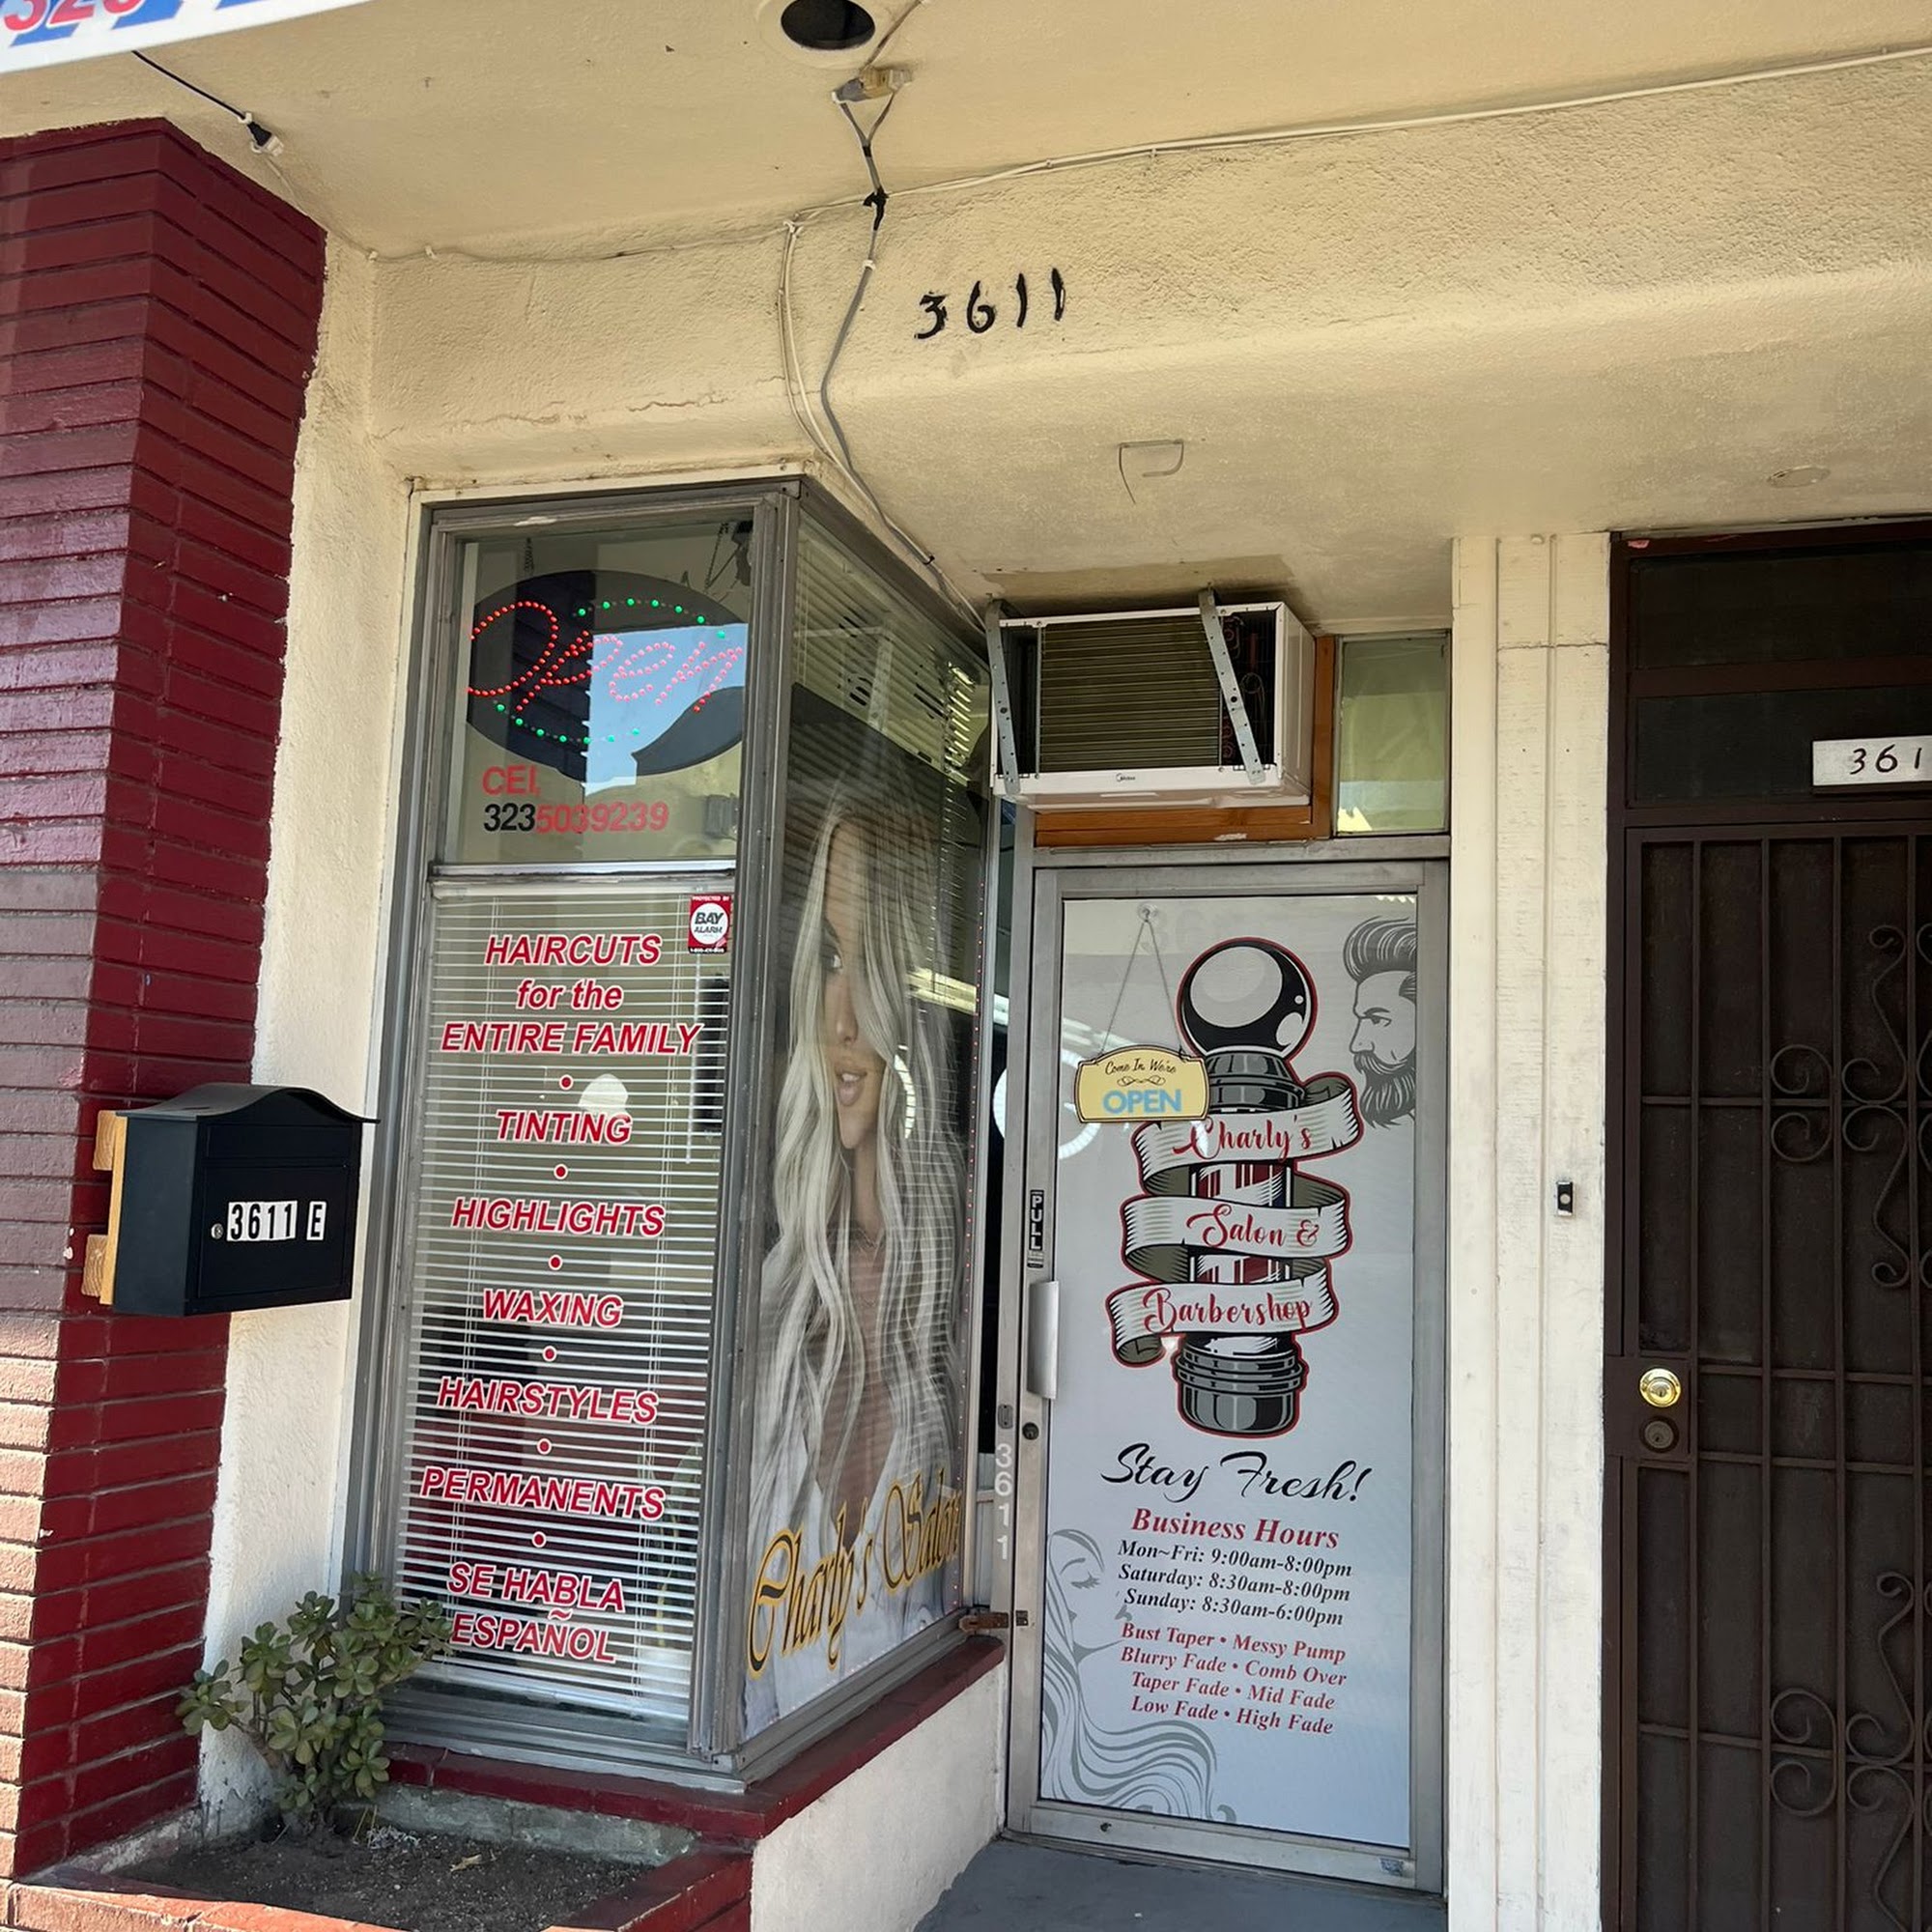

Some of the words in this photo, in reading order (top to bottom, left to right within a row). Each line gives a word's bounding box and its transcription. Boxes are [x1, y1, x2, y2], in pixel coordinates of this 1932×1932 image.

[914, 267, 1066, 339] 3611
[1849, 744, 1921, 775] 361
[695, 912, 724, 924] BAY
[484, 934, 662, 966] HAIRCUTS
[516, 979, 564, 1009] for
[570, 979, 623, 1009] the
[440, 1022, 566, 1052] ENTIRE
[572, 1023, 703, 1055] FAMILY
[1102, 1089, 1182, 1114] OPEN
[497, 1111, 632, 1145] TINTING
[1172, 1115, 1312, 1163] Charly's
[230, 1204, 293, 1239] 3611
[311, 1204, 322, 1238] E
[451, 1197, 666, 1237] HIGHLIGHTS
[1030, 1195, 1042, 1250] PULL
[1186, 1204, 1287, 1247] Salon
[1296, 1219, 1320, 1247] &
[483, 1289, 624, 1328] WAXING
[1143, 1288, 1311, 1334] Barbershop
[437, 1376, 659, 1424] HAIRSTYLES
[419, 1464, 667, 1521] PERMANENTS
[1100, 1442, 1209, 1503] Stay
[1220, 1450, 1372, 1502] Fresh!
[994, 1443, 1013, 1560] 3611
[1131, 1507, 1245, 1541] Business
[1254, 1519, 1340, 1549] Hours
[1118, 1564, 1204, 1590] Saturday:
[1208, 1572, 1350, 1604] 8:30am-8:00pm
[1210, 1548, 1352, 1579] 9:00am-8:00pm
[446, 1562, 497, 1597] SE
[502, 1566, 626, 1613] HABLA
[1123, 1587, 1196, 1613] Sunday:
[1202, 1596, 1344, 1628] 8:30am-6:00pm
[450, 1608, 616, 1663] ESPAÑOL
[1122, 1622, 1160, 1641] Bust
[1166, 1627, 1215, 1649] Taper
[1233, 1634, 1288, 1659] Messy
[1293, 1640, 1347, 1665] Pump
[1121, 1646, 1177, 1670] Blurry
[1182, 1653, 1227, 1673] Fade
[1245, 1660, 1297, 1681] Comb
[1303, 1666, 1348, 1687] Over
[1131, 1671, 1180, 1693] Taper
[1185, 1678, 1230, 1697] Fade
[1247, 1685, 1283, 1704] Mid
[1290, 1690, 1336, 1710] Fade
[1131, 1695, 1169, 1714] Low
[1175, 1700, 1219, 1720] Fade
[1236, 1708, 1281, 1730] High
[1288, 1714, 1334, 1735] Fade
